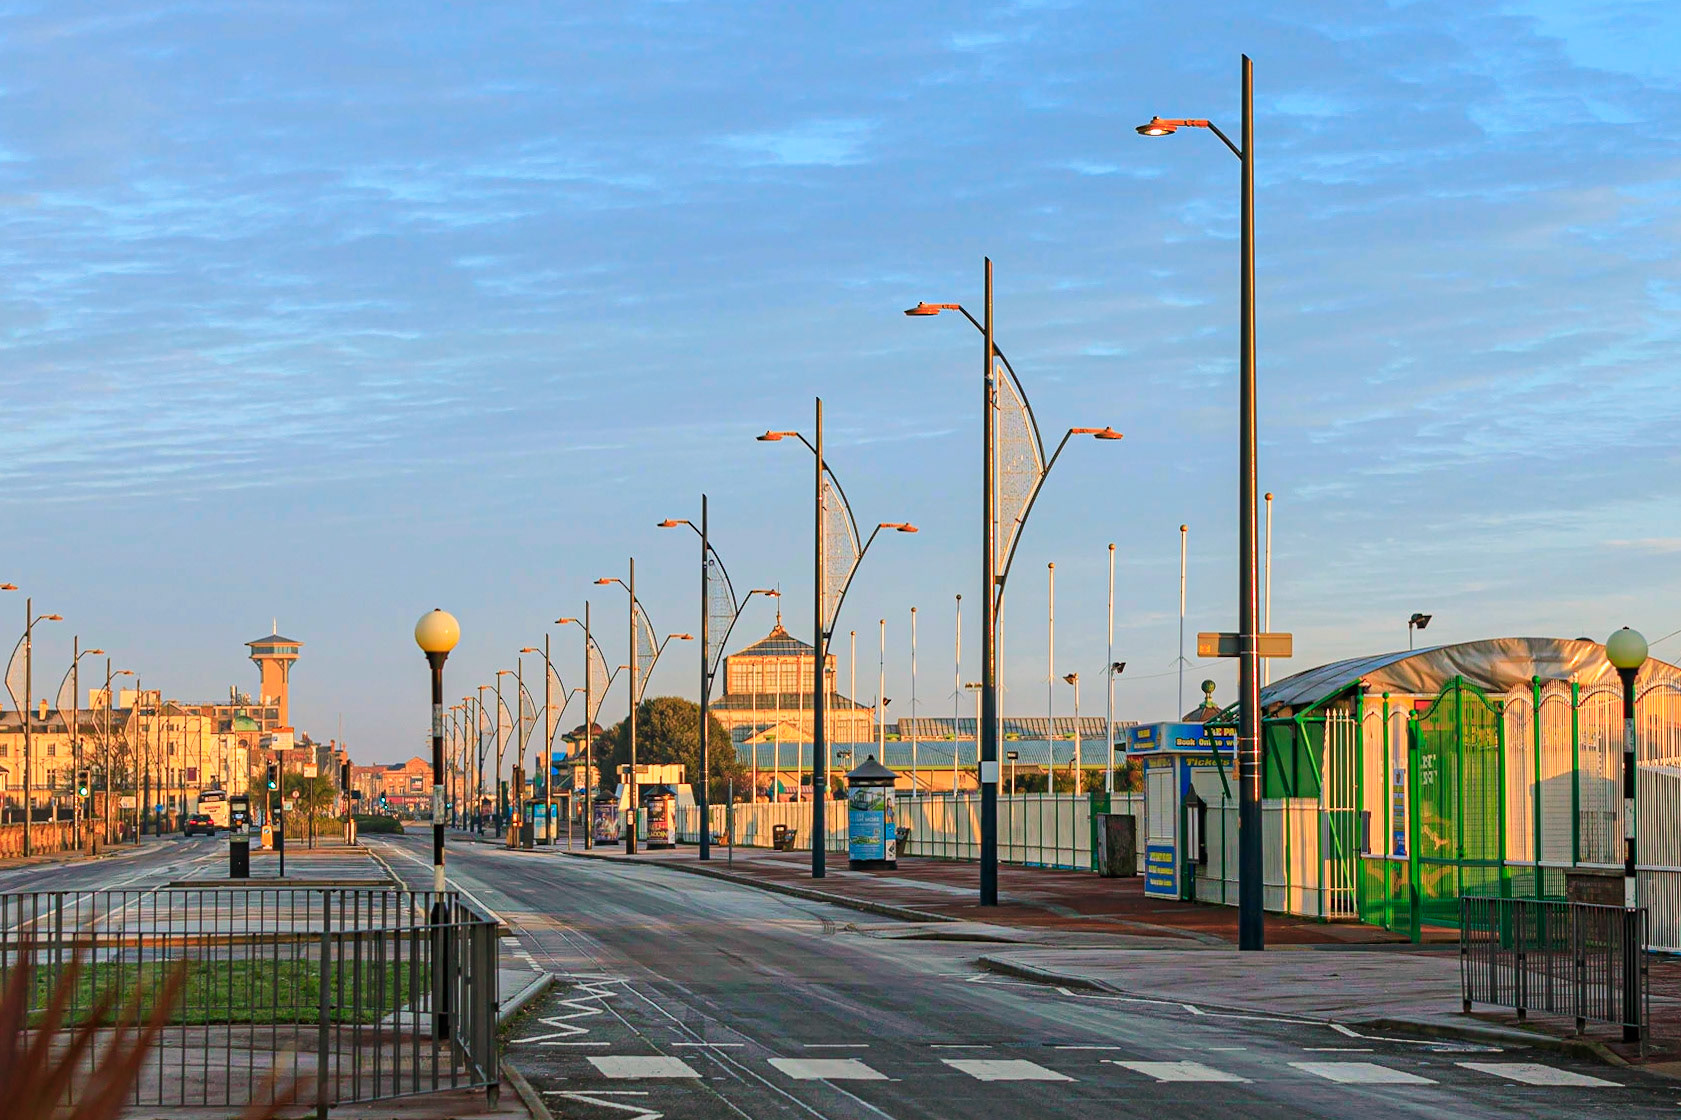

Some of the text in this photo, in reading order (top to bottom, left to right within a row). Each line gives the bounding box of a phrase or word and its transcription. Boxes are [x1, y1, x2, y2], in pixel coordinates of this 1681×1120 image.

[1176, 738, 1196, 746] Book
[1198, 738, 1223, 746] Onlne
[1186, 758, 1230, 766] Tickes
